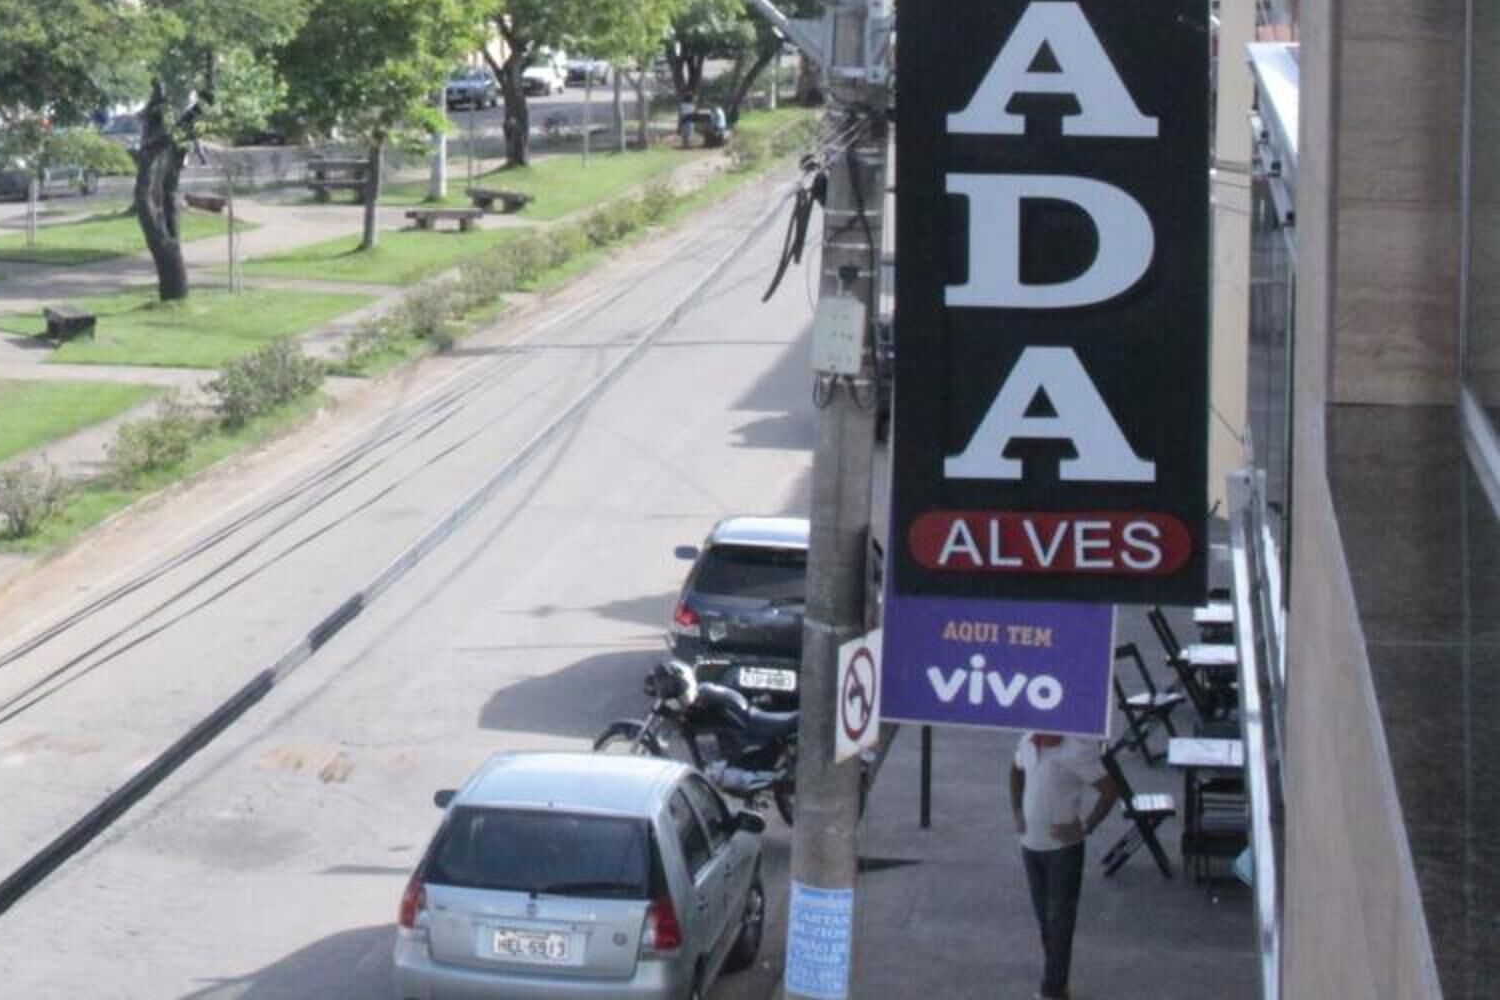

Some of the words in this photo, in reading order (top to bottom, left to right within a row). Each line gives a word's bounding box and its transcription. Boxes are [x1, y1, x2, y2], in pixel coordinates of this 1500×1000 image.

[937, 518, 1163, 571] ALVES
[943, 621, 999, 643] AQUI
[1007, 625, 1054, 647] TEM
[926, 653, 1064, 711] vivo
